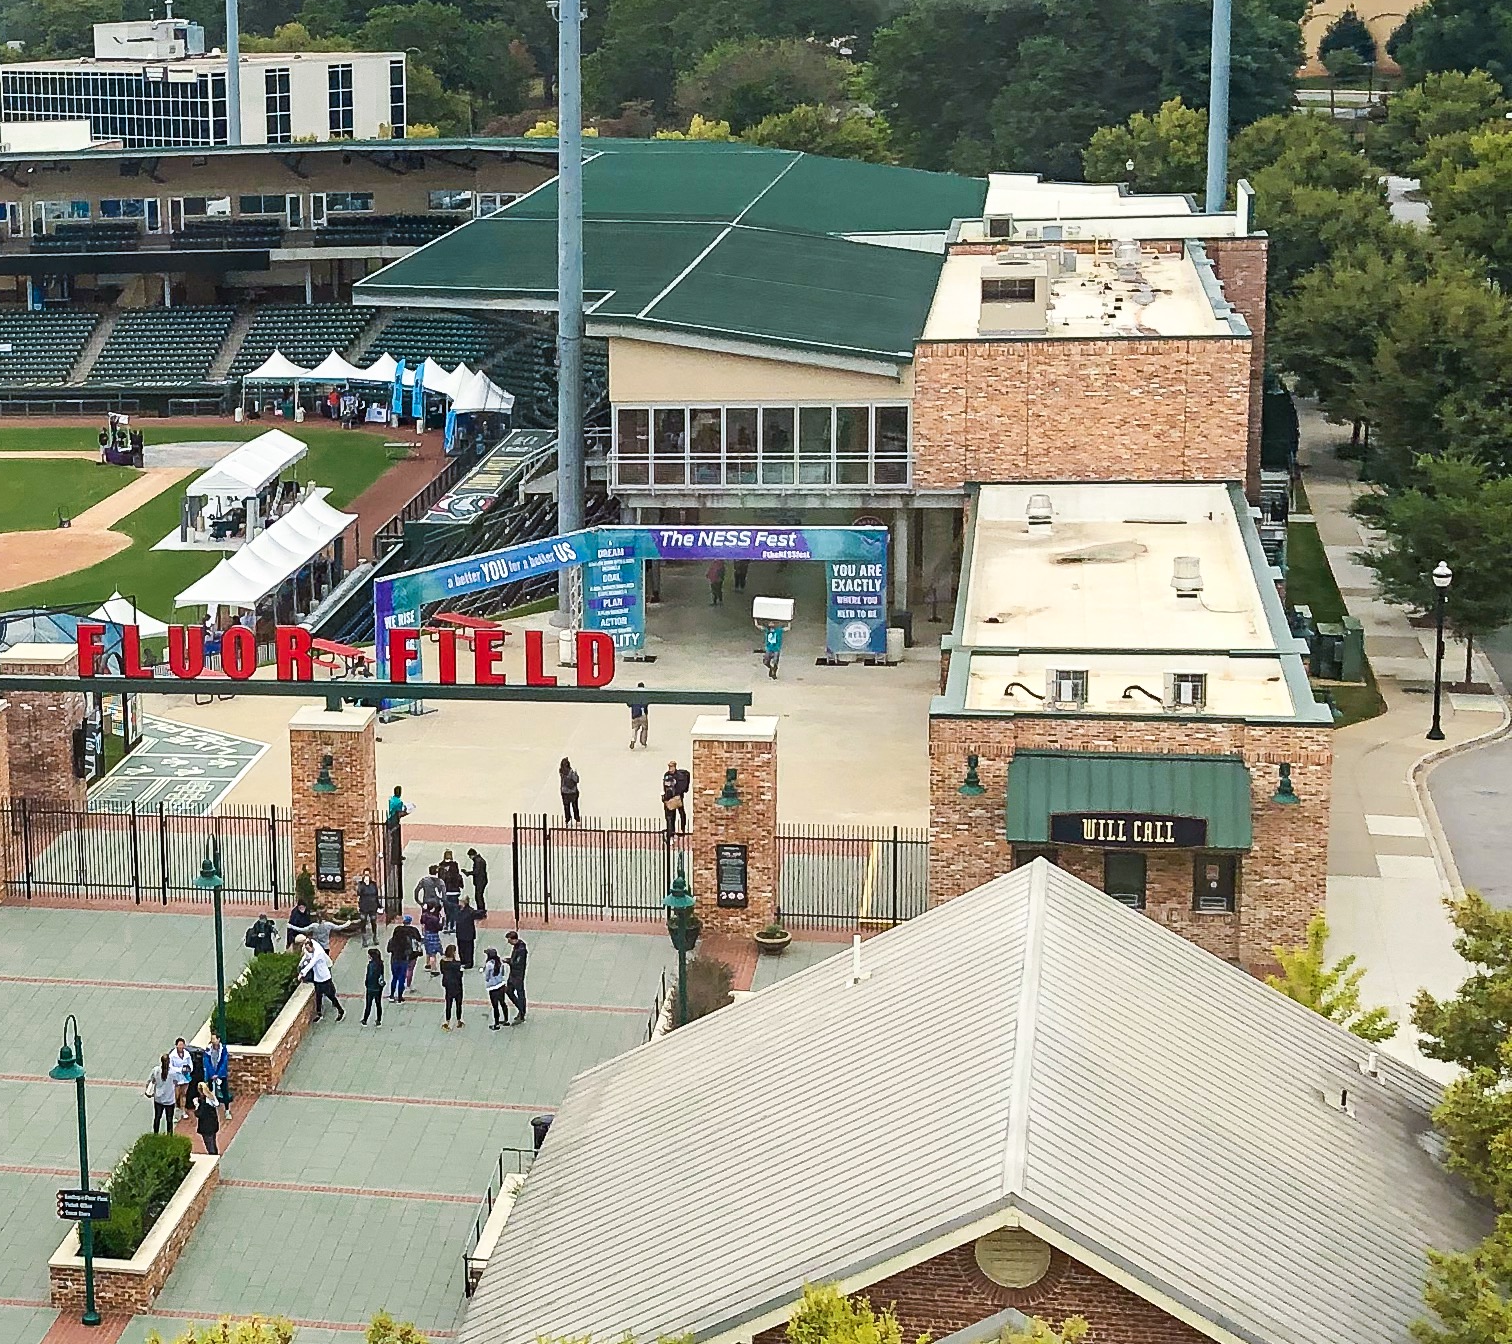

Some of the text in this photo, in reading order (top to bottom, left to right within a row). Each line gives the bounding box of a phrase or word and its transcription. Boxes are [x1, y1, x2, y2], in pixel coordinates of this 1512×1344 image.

[660, 531, 797, 547] The NESS Fest
[447, 541, 577, 588] a better YOU for a better US
[832, 564, 883, 577] YOU ARE
[831, 578, 882, 592] EXACTLY
[603, 598, 623, 608] PLAN
[836, 596, 878, 605] WHERE YOU
[384, 610, 415, 630] WE RISE
[857, 609, 867, 618] TO
[614, 632, 640, 648] LITY
[77, 624, 314, 681] FLUOR
[391, 628, 616, 688] FIELD
[1082, 818, 1175, 843] WILL CALL
